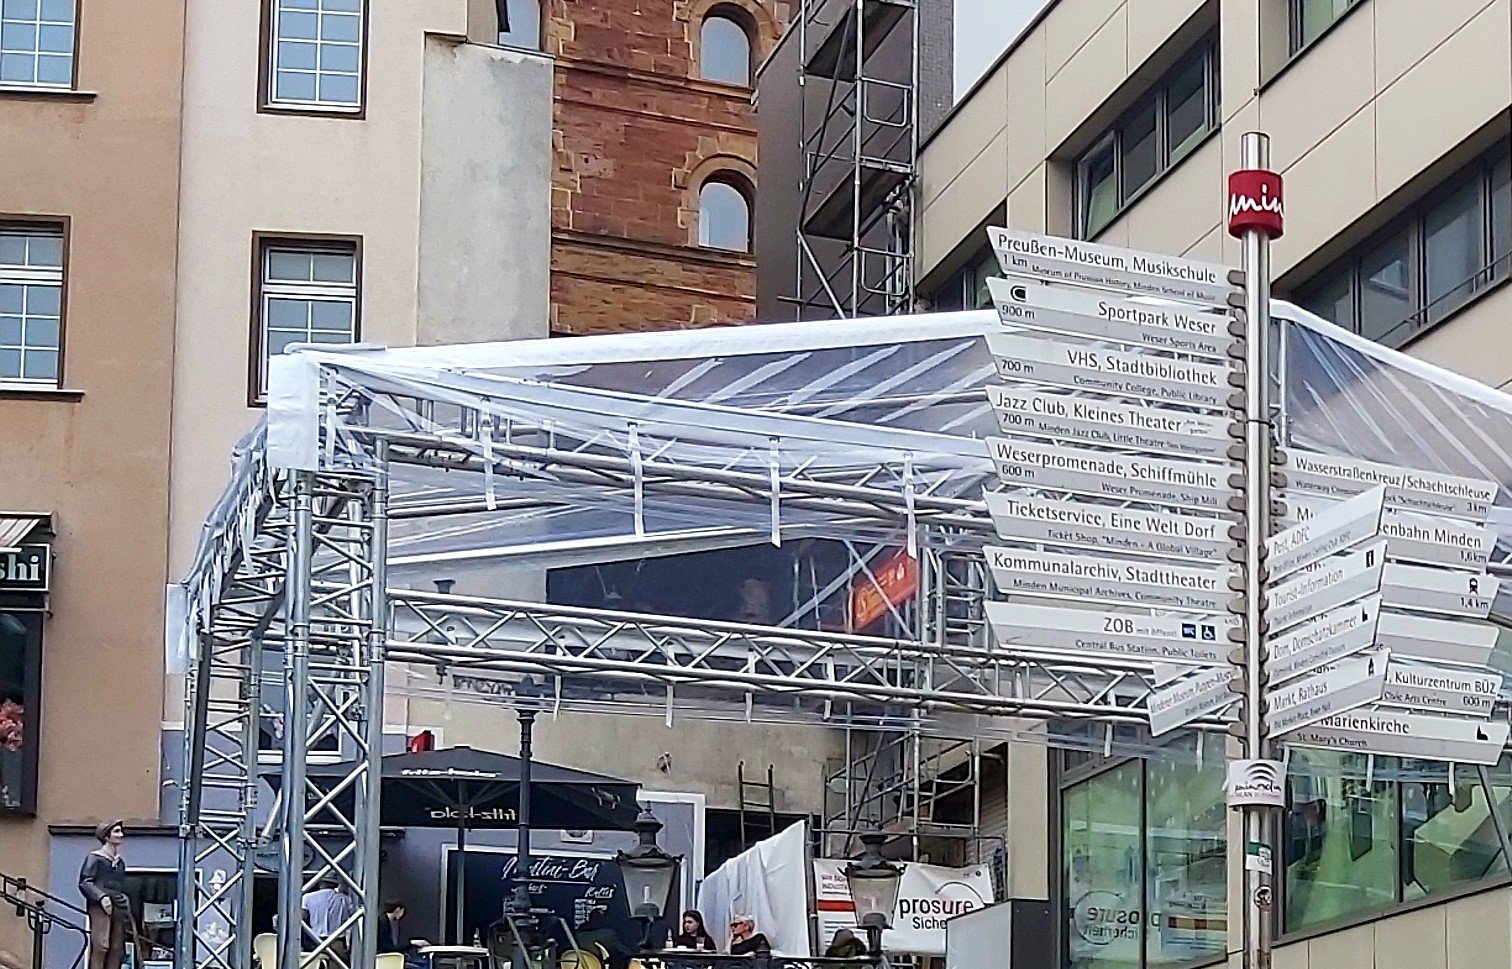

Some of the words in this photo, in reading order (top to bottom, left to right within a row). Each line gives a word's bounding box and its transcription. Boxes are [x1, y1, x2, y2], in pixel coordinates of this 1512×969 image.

[998, 233, 1129, 272] Preußen-Museum,
[1133, 256, 1217, 284] Musikschule
[1012, 255, 1028, 268] km
[1002, 304, 1023, 317] 900
[1025, 310, 1035, 320] m
[1098, 301, 1168, 327] Sportpark
[1174, 315, 1216, 334] Weser
[1198, 341, 1217, 353] Area
[1001, 359, 1022, 372] 700
[1024, 364, 1034, 374] m
[1067, 350, 1102, 371] VHS,
[1106, 355, 1218, 386] Stadtbibliothek
[996, 392, 1027, 411] Jazz
[1032, 397, 1068, 418] Club,
[1074, 403, 1124, 425] Kleines
[1128, 410, 1181, 432] Theater
[1002, 413, 1023, 426] 700
[1025, 418, 1035, 428] m
[1072, 427, 1090, 438] Jazz
[997, 443, 1127, 478] Weserpromenade,
[1131, 462, 1218, 488] Schiffmühle
[1002, 464, 1023, 477] 600
[1025, 469, 1035, 479] m
[1295, 457, 1491, 500] Wasserstraßenkreuz/Schachtschleuse
[1007, 499, 1105, 527] Ticketservice,
[1111, 513, 1141, 531] Eine
[1146, 516, 1178, 535] Welt
[1185, 522, 1215, 538] Dorf
[1434, 528, 1481, 548] Minden
[994, 553, 1122, 582] Kommunalarchiv,
[1126, 566, 1217, 590] Stadttheater
[1013, 578, 1047, 591] Minden
[1103, 617, 1134, 634] ZOB
[1076, 639, 1108, 651] Central
[1110, 640, 1125, 652] Bus
[1298, 682, 1328, 702] Rathaus
[1395, 671, 1471, 692] Kulturzentrum
[1475, 678, 1497, 695] BÜZ
[1462, 696, 1479, 707] 600
[1481, 699, 1491, 708] m
[1321, 715, 1410, 735] Marienkirche
[1339, 737, 1367, 748] Church
[900, 898, 974, 919] prosure
[913, 917, 947, 930] Siche
